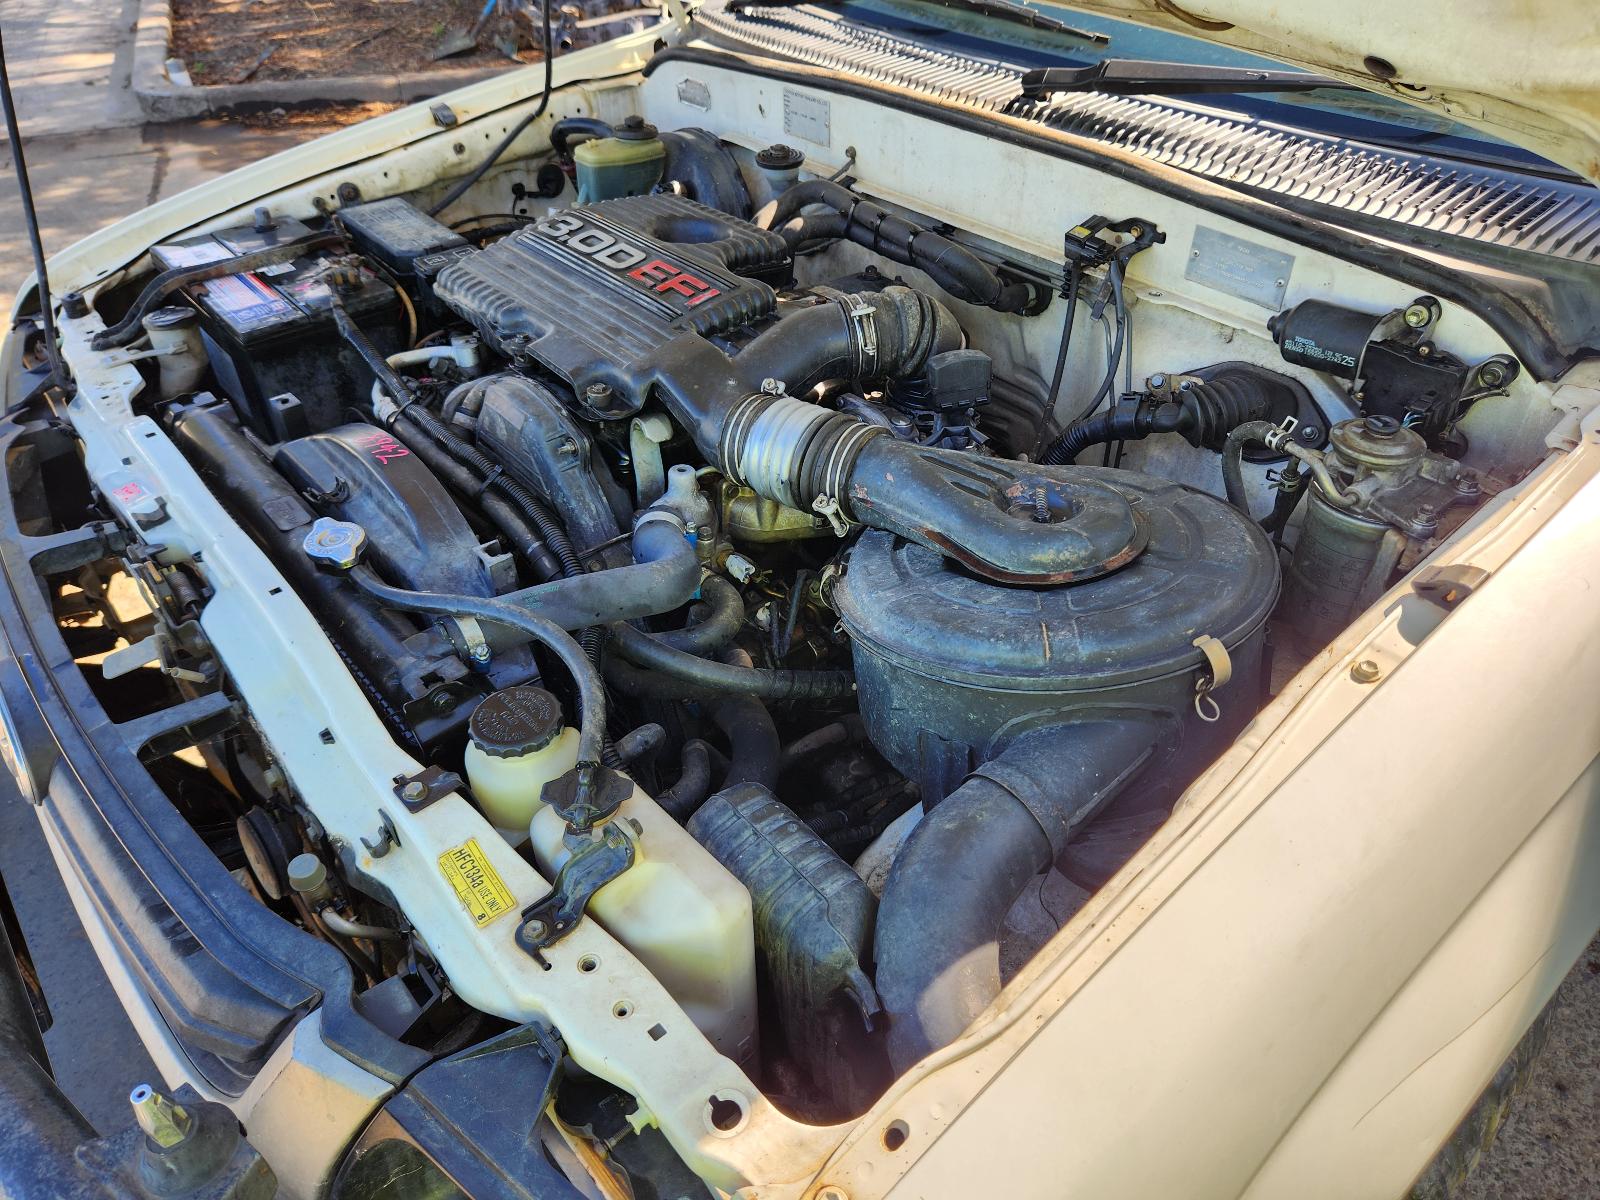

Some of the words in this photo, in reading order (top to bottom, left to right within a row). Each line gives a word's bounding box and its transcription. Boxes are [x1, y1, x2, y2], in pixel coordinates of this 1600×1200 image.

[1295, 336, 1315, 347] TOYOTA
[1341, 356, 1355, 366] 25
[452, 848, 484, 889] HFC134a
[478, 886, 492, 900] USE
[486, 897, 502, 913] ONLY
